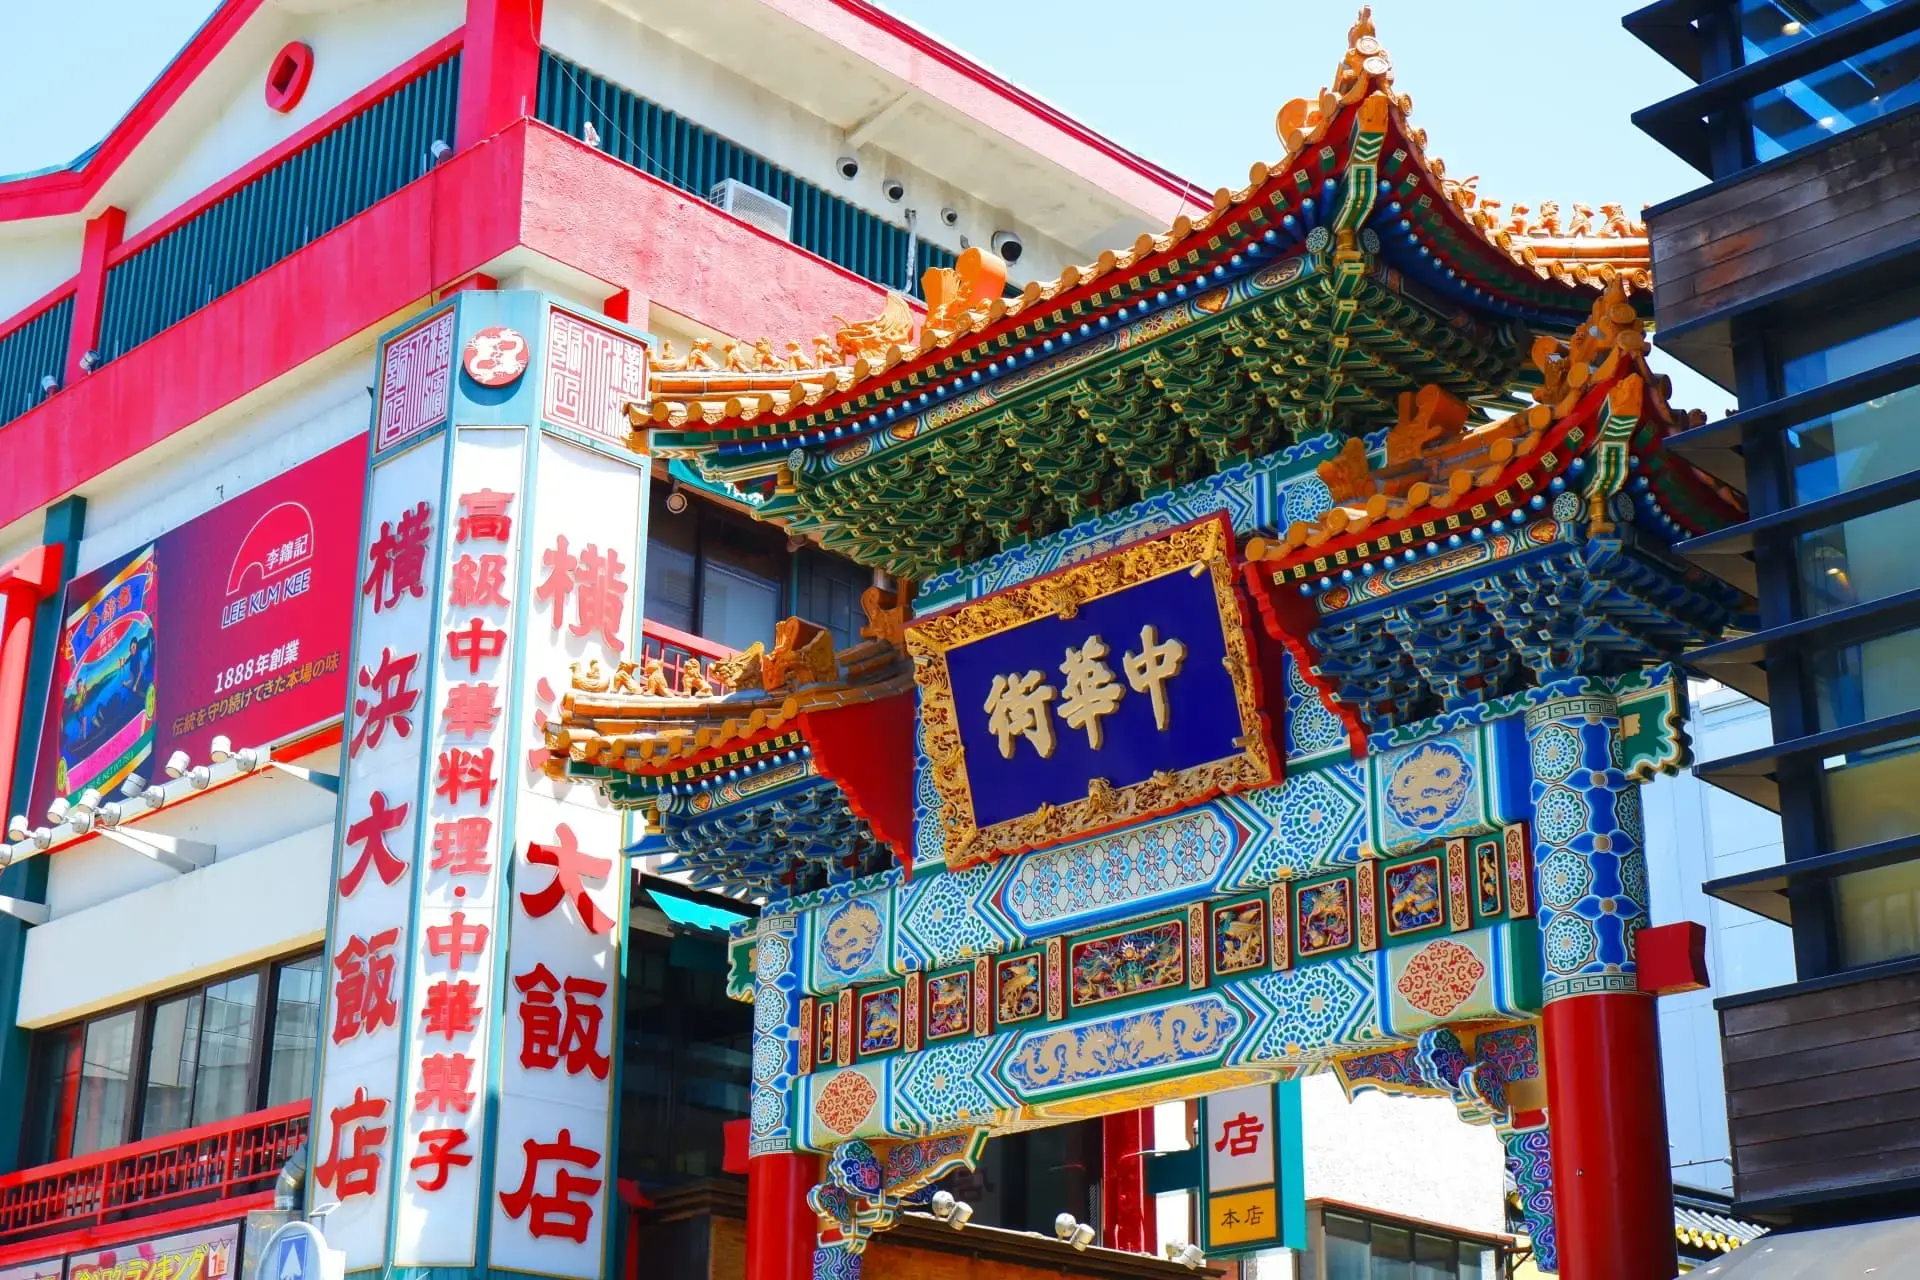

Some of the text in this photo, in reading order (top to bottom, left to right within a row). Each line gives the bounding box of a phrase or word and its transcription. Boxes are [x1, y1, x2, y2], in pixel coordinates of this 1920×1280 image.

[265, 533, 308, 569] 李錦記
[221, 568, 312, 629] LEE KUM KEE
[172, 651, 341, 736] 伝統を守り続けてきた本場の味
[214, 638, 300, 694] 1888年創業
[315, 501, 433, 1201] 横浜大飯店
[1215, 1112, 1264, 1157] 店
[1220, 1205, 1264, 1229] 本店
